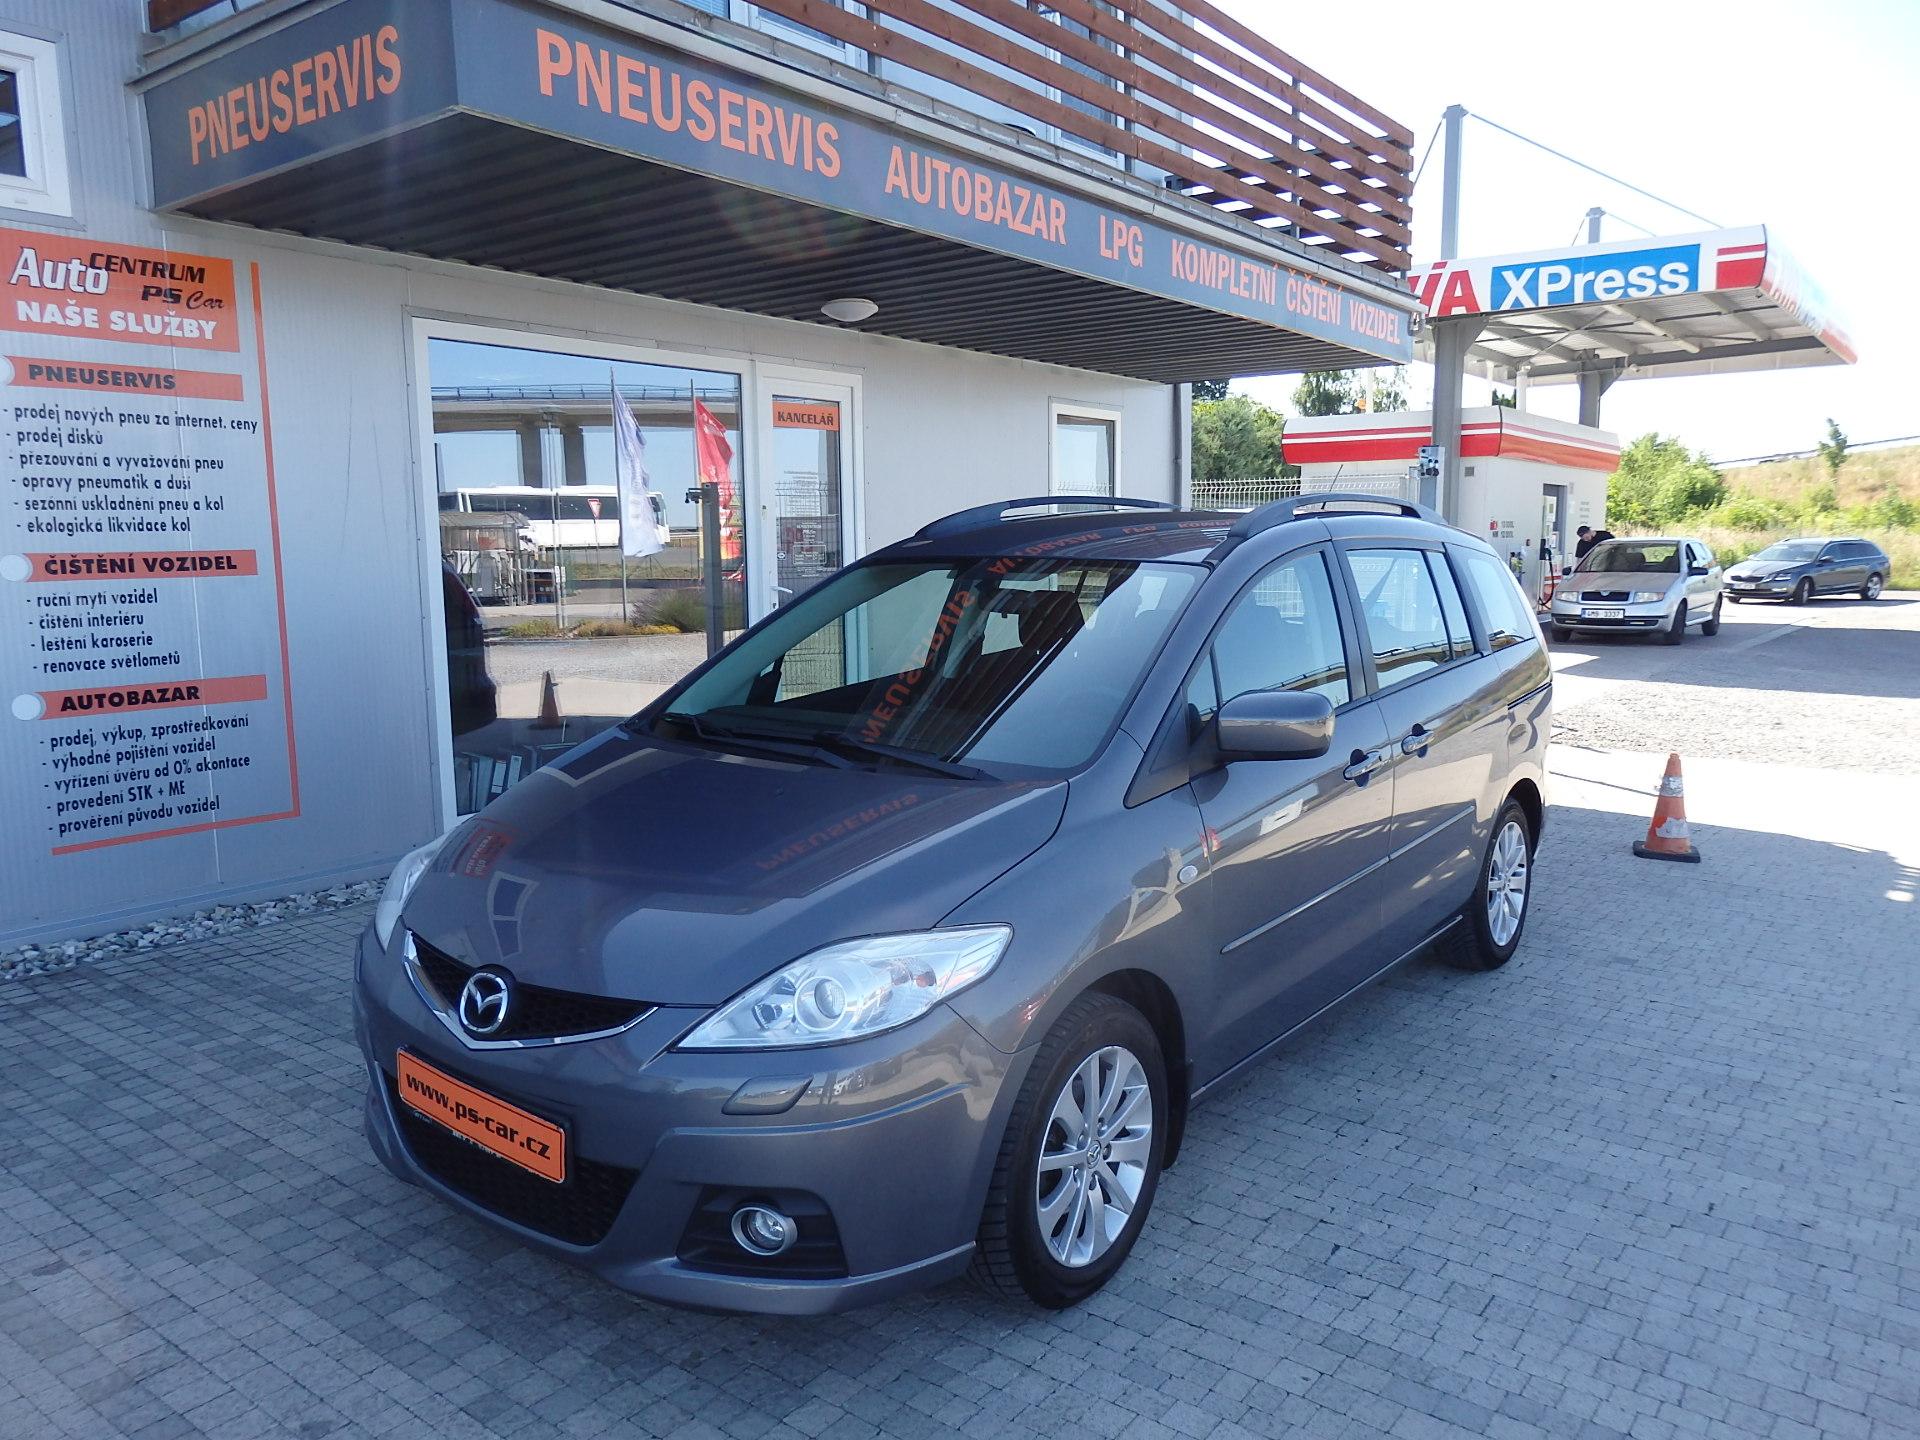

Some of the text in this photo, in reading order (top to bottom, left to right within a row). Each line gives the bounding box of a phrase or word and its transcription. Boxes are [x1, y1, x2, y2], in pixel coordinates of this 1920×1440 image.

[188, 25, 401, 166] PNEUSERVIS
[536, 28, 1401, 345] PNEUSERVIS AUTOBAZAR LPG KOMPLETNÍ ČIŠTĚNÍ VOZIDEL
[8, 246, 206, 295] Auto CENTRUM
[141, 285, 225, 310] PS Car
[1500, 262, 1690, 311] XPress
[16, 298, 217, 340] NAŠE SLUŽBY
[28, 364, 177, 390] PNEUSERVIS
[14, 403, 258, 434] prodej nových pneu za internet. ceny
[777, 411, 834, 426] KANCELÁŘ
[17, 426, 103, 448] prodej disků
[20, 450, 224, 473] přezouvání a vyvažování pneu
[22, 473, 191, 492] opravy pneumatik a duší
[25, 494, 224, 515] sezónní uskladnění pneu a kol
[27, 515, 191, 537] ekologická likvidace kol
[44, 554, 237, 575] ČIŠTĚNÍ VOZIDEL
[36, 587, 158, 609] ruční mytí vozidel
[39, 610, 144, 629] čištění interiéru
[41, 630, 153, 651] leštění karoserie
[43, 650, 180, 673] renovace světlometů
[60, 685, 200, 711] AUTOBAZAR
[50, 713, 249, 752] prodej, výkup, zprostředkování
[52, 735, 216, 773] výhodné pojištění vozidel
[54, 756, 251, 794] vyřízení úvěru od 0% akontace
[57, 790, 124, 817] provedení
[128, 784, 153, 802] STK
[169, 780, 185, 797] ME
[58, 794, 220, 838] prověření původu vozidel
[405, 1073, 551, 1160] www.ps-car.cz
